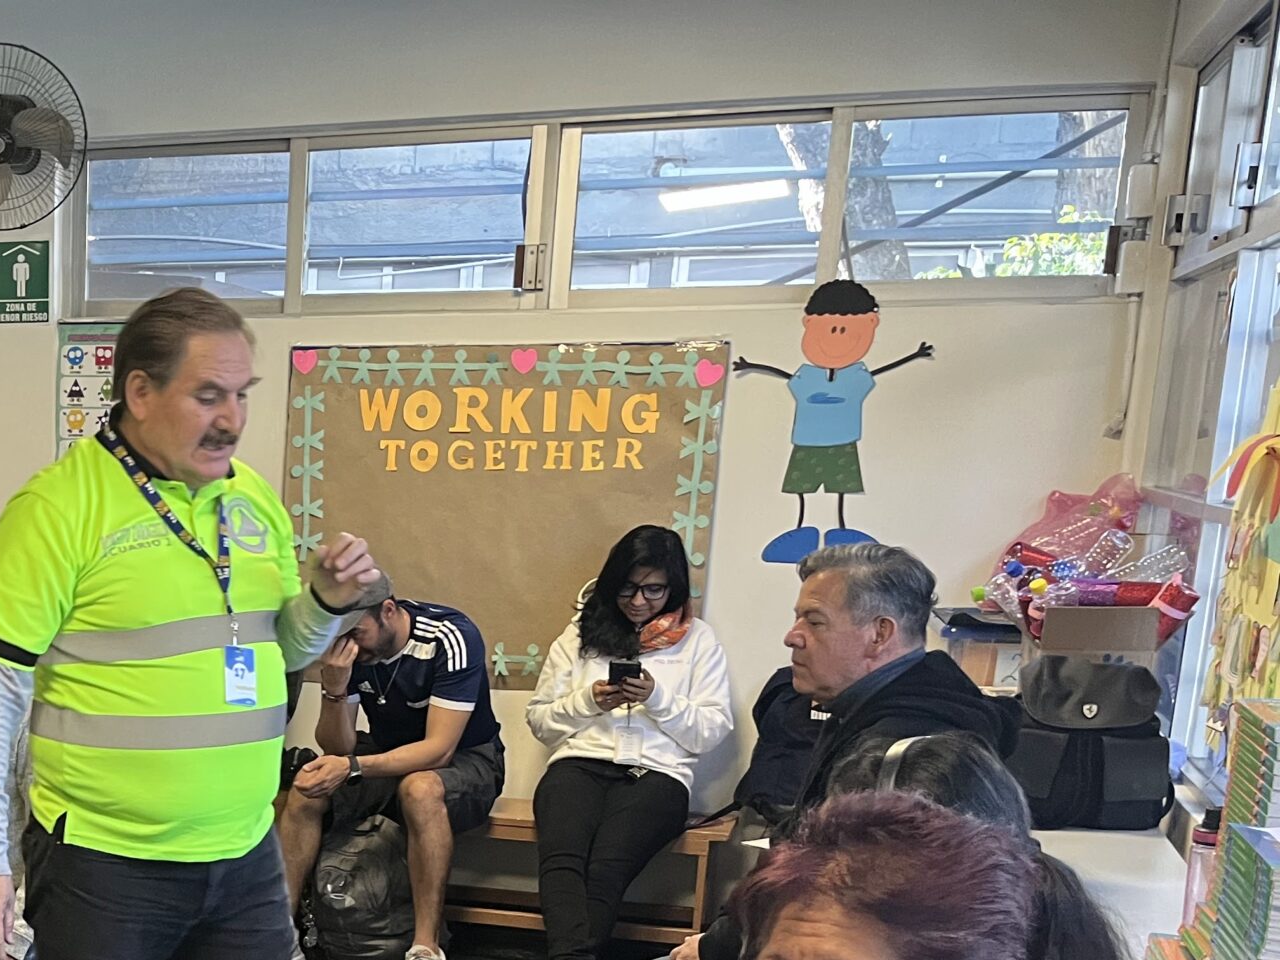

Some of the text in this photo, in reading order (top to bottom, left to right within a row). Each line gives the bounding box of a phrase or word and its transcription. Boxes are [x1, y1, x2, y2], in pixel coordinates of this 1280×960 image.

[5, 302, 37, 312] ZONA DE
[21, 312, 48, 322] RIESGO
[359, 386, 660, 434] WORKING
[379, 437, 644, 472] TOGETHER
